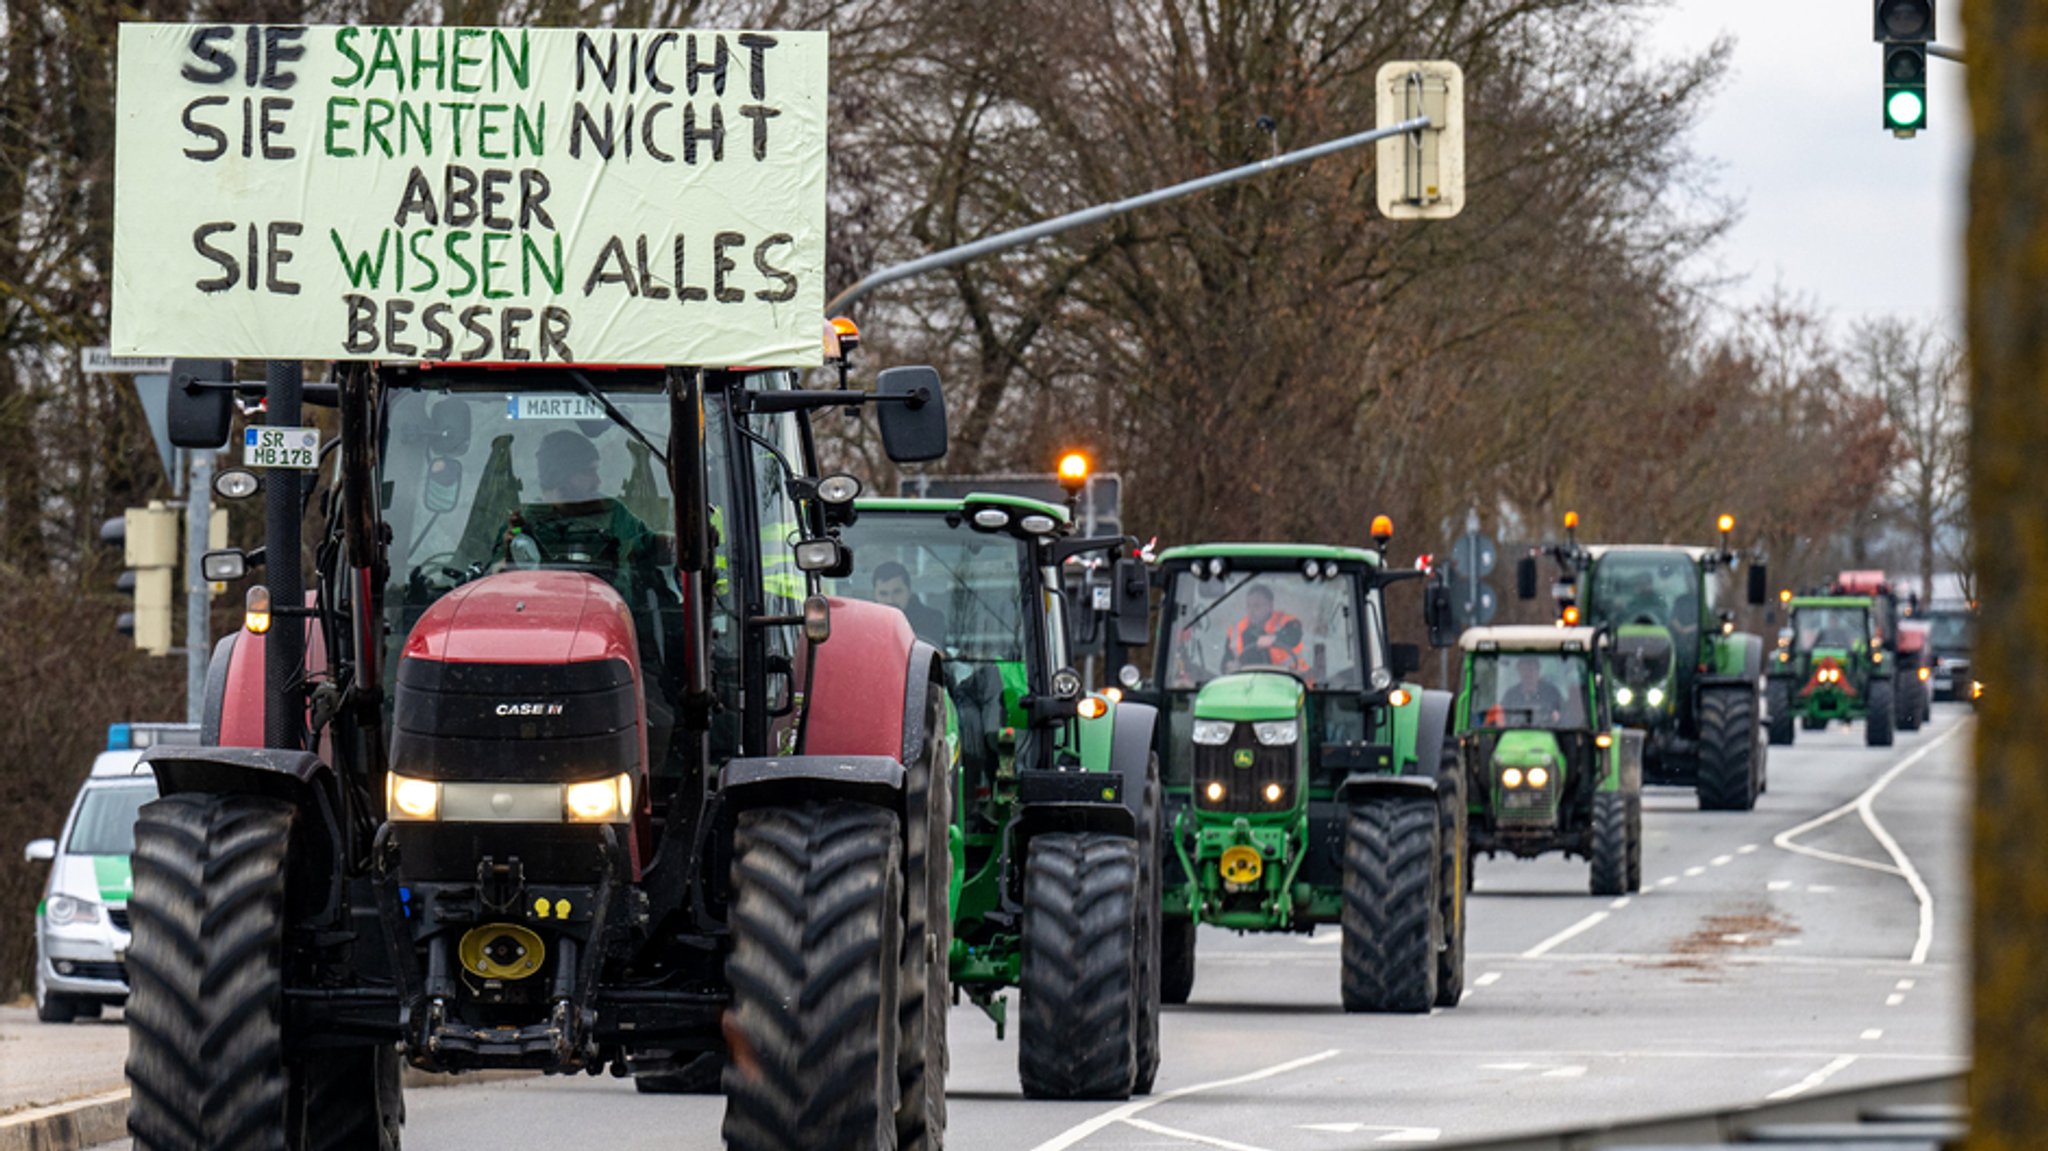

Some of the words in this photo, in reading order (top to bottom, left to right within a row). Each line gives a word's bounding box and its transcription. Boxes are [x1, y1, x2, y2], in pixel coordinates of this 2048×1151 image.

[181, 26, 308, 90] SIE
[331, 26, 530, 93] SÄHEN
[576, 31, 779, 101] NICHT
[182, 95, 296, 162] SIE
[325, 96, 545, 159] ERNTEN
[569, 101, 782, 165] NICHT
[394, 163, 556, 231] ABER
[193, 222, 303, 295] SIE
[330, 227, 564, 299] WISSEN
[583, 231, 798, 305] ALLES
[342, 294, 574, 362] BESSER
[262, 431, 284, 448] SR
[526, 399, 596, 416] MARTIN
[280, 449, 312, 465] 178
[496, 703, 544, 716] CASE
